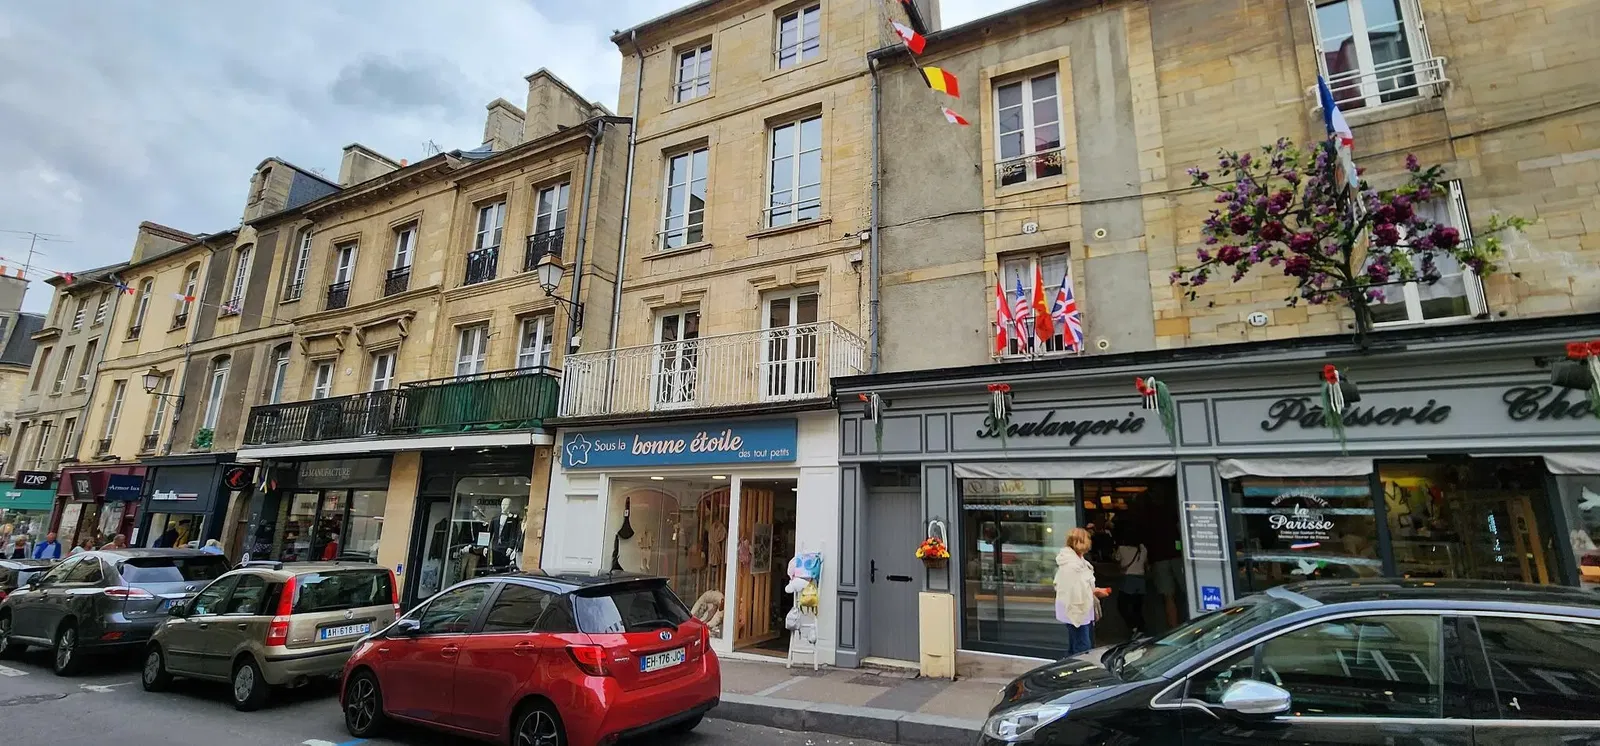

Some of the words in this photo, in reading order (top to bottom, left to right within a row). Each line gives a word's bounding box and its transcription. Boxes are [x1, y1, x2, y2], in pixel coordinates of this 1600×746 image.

[1026, 224, 1035, 232] 15
[594, 439, 616, 452] Sous
[618, 438, 626, 451] la
[631, 434, 687, 455] bonne
[689, 428, 744, 453] étoile
[738, 448, 751, 458] des
[753, 449, 767, 457] tout
[769, 448, 790, 460] petits
[1294, 503, 1309, 515] la
[1268, 514, 1335, 530] Parisse
